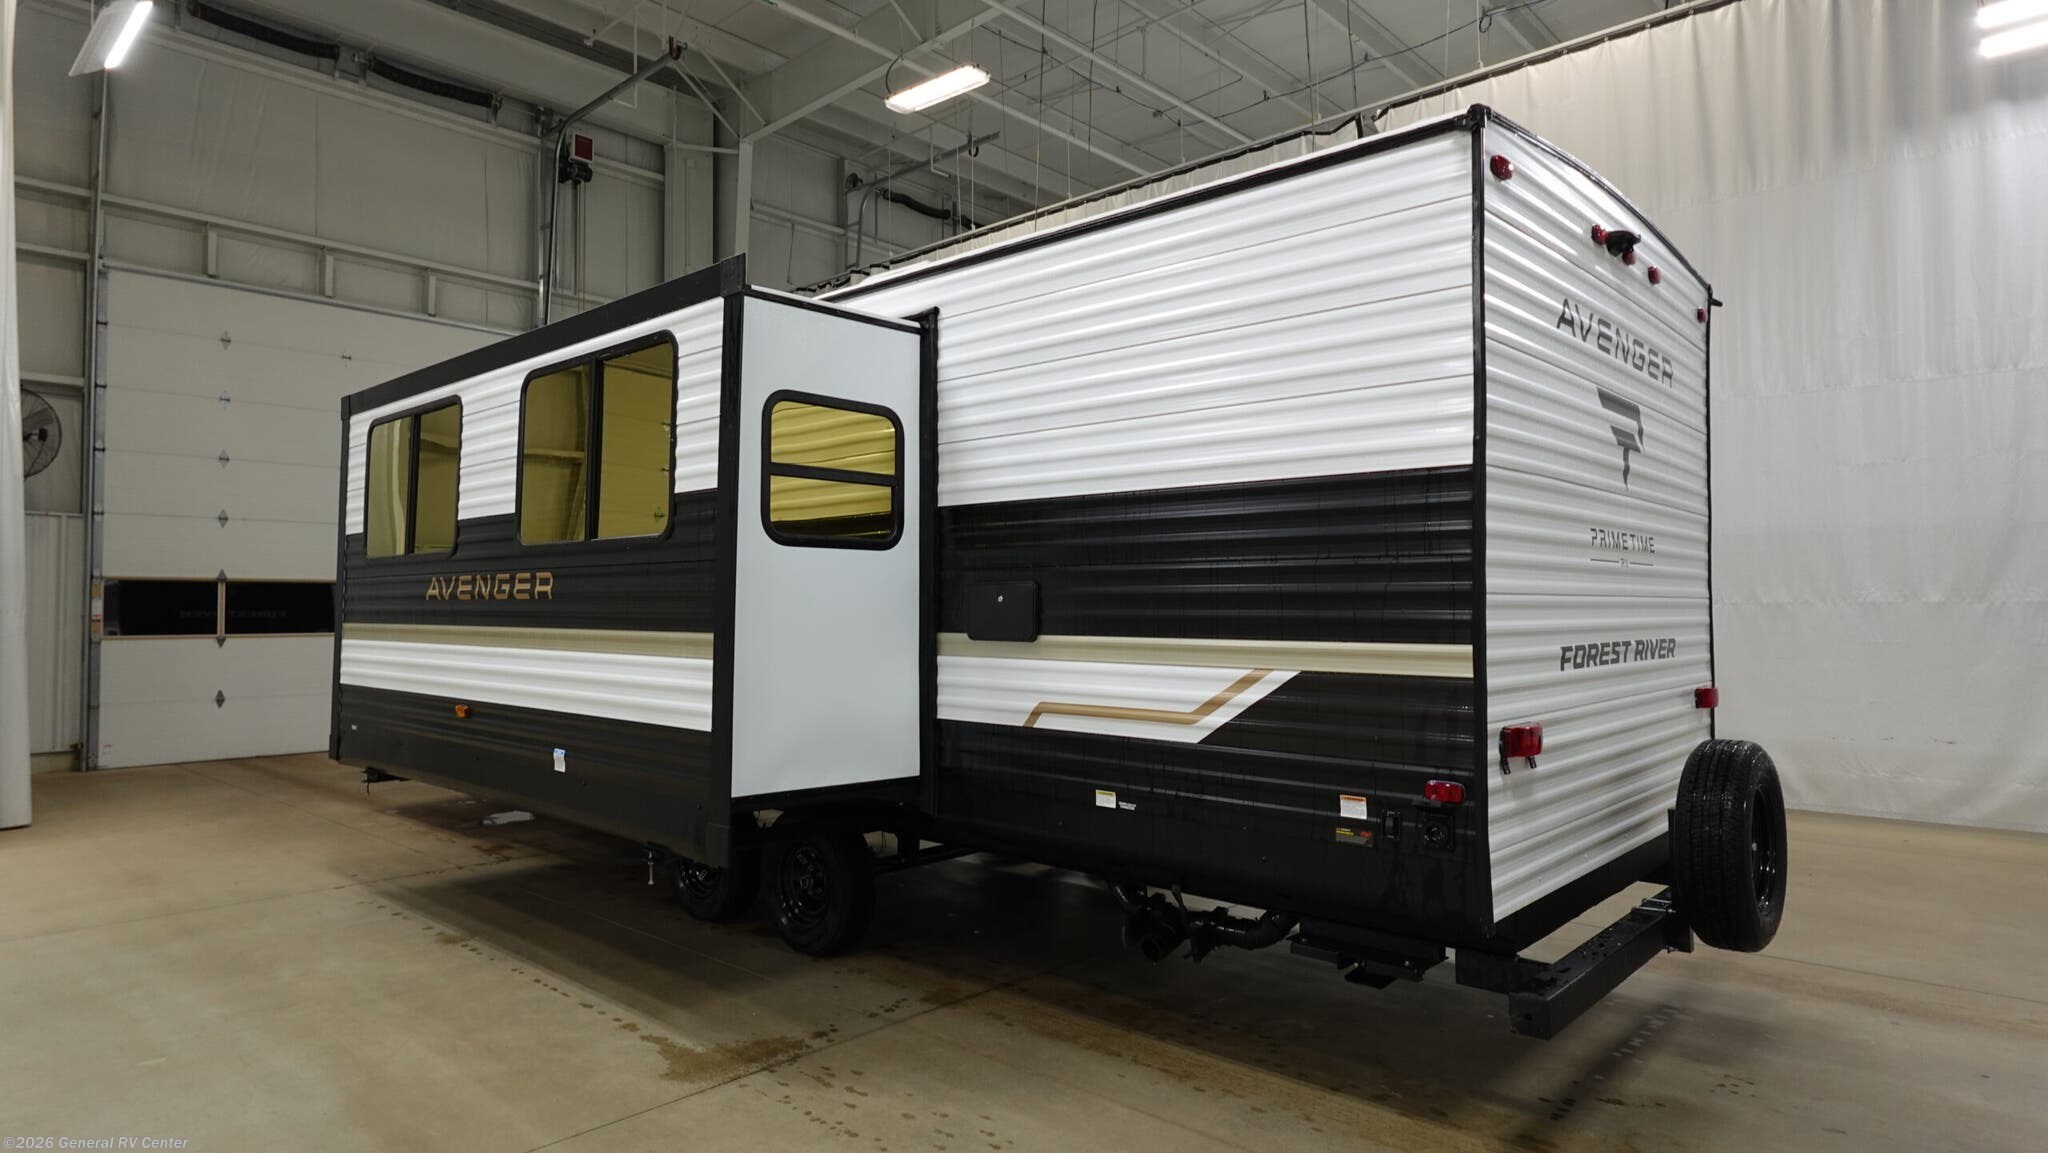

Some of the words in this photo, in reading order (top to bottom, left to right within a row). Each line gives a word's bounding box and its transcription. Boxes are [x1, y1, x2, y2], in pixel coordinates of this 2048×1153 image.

[1556, 297, 1674, 388] AVENGER
[1590, 527, 1656, 554] PRIMETIME
[426, 571, 554, 601] AVENGER
[1560, 640, 1632, 672] FOREST
[1634, 638, 1677, 662] RIVER
